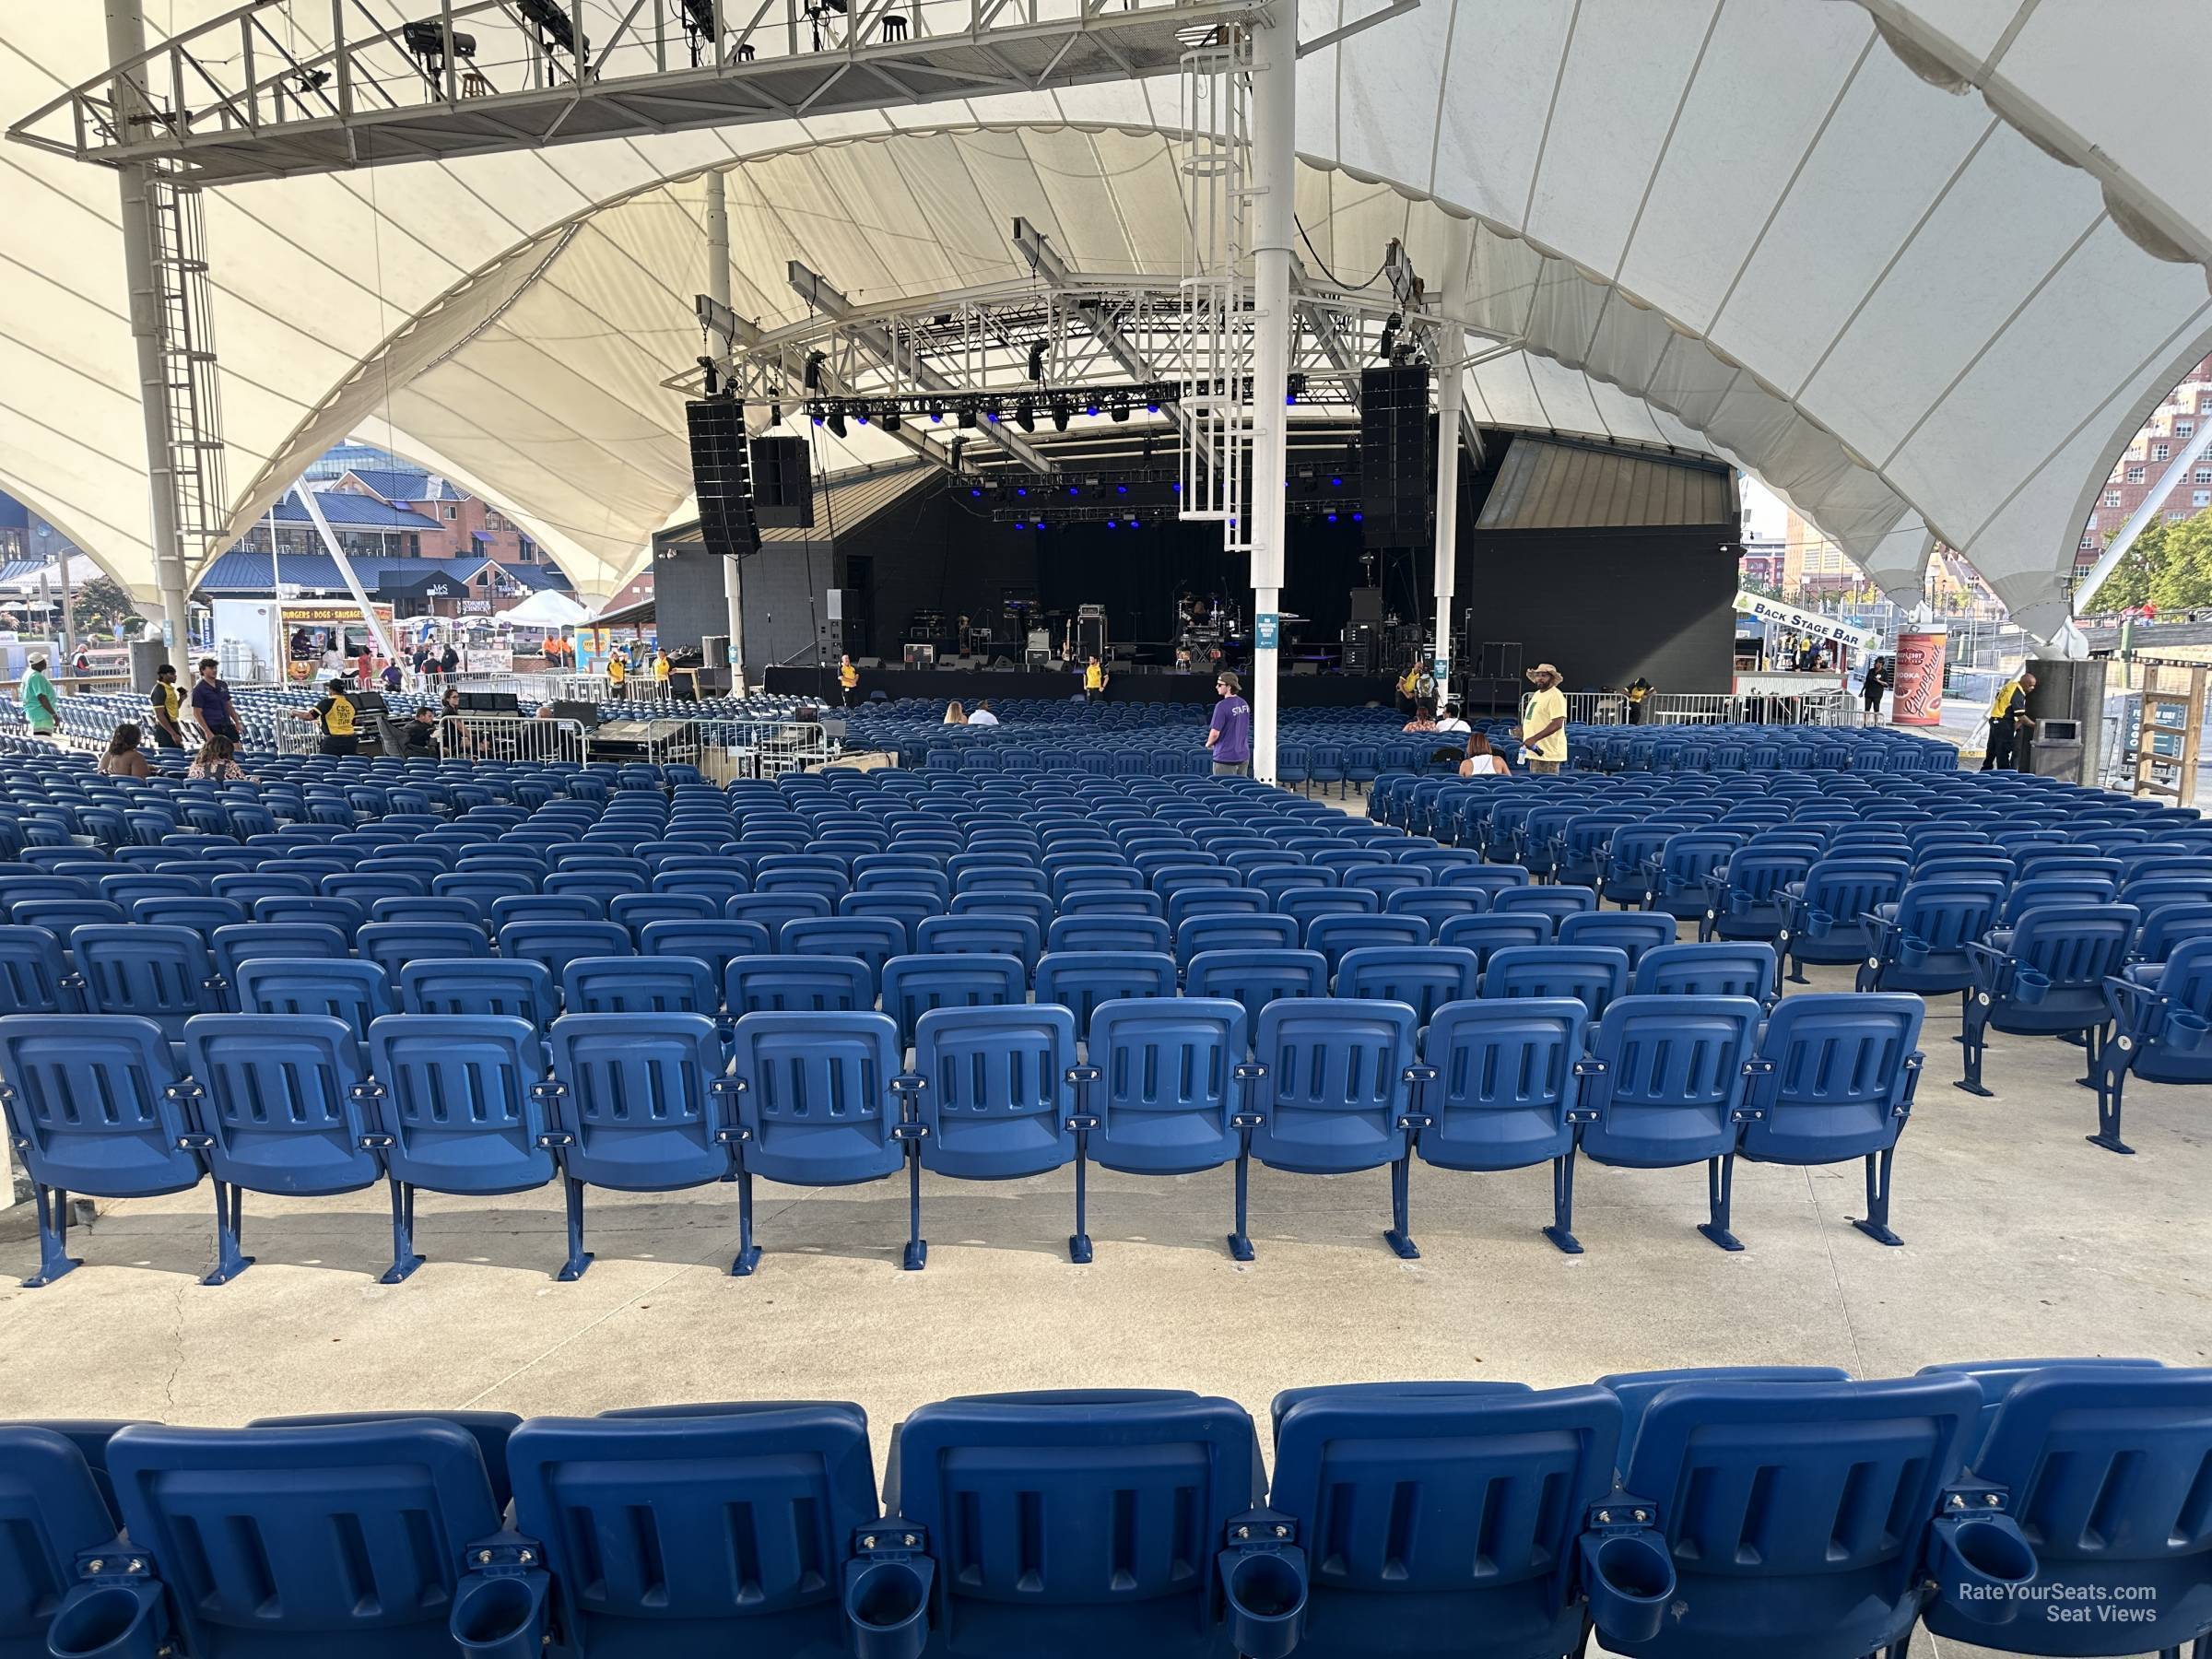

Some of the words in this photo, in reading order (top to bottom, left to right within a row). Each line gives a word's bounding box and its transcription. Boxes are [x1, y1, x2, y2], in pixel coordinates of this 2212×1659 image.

[282, 611, 311, 619] BURGERS
[1754, 603, 1787, 622] BACK
[1791, 615, 1830, 635] STAGE
[1832, 628, 1859, 645] BAR
[1903, 645, 1941, 717] Grapefruit
